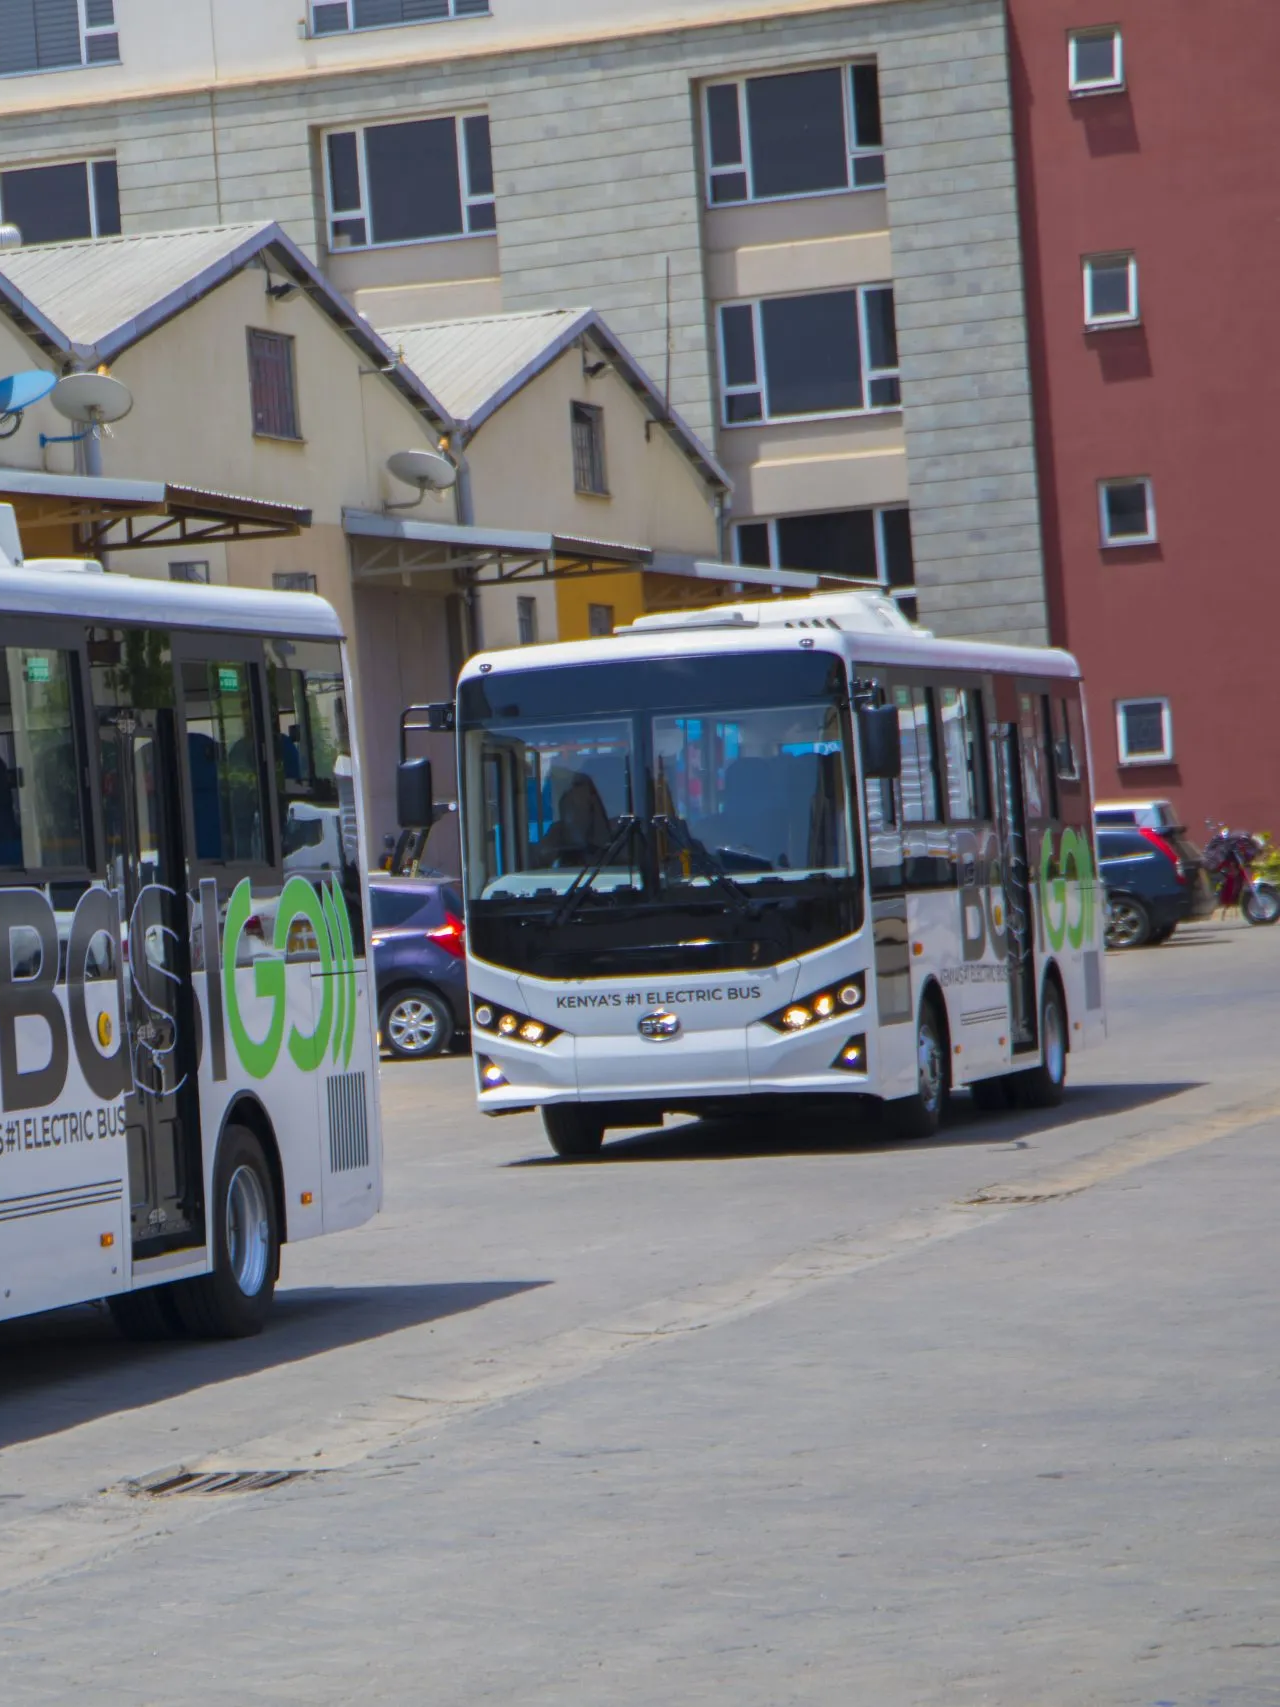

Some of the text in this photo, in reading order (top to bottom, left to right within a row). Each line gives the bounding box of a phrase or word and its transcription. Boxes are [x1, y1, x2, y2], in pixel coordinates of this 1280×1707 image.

[556, 986, 761, 1009] KENYA'S #1 ELECTRIC BUS
[6, 1120, 21, 1152] #1
[23, 1109, 94, 1150] ELECTRIC
[97, 1105, 126, 1140] BUS
